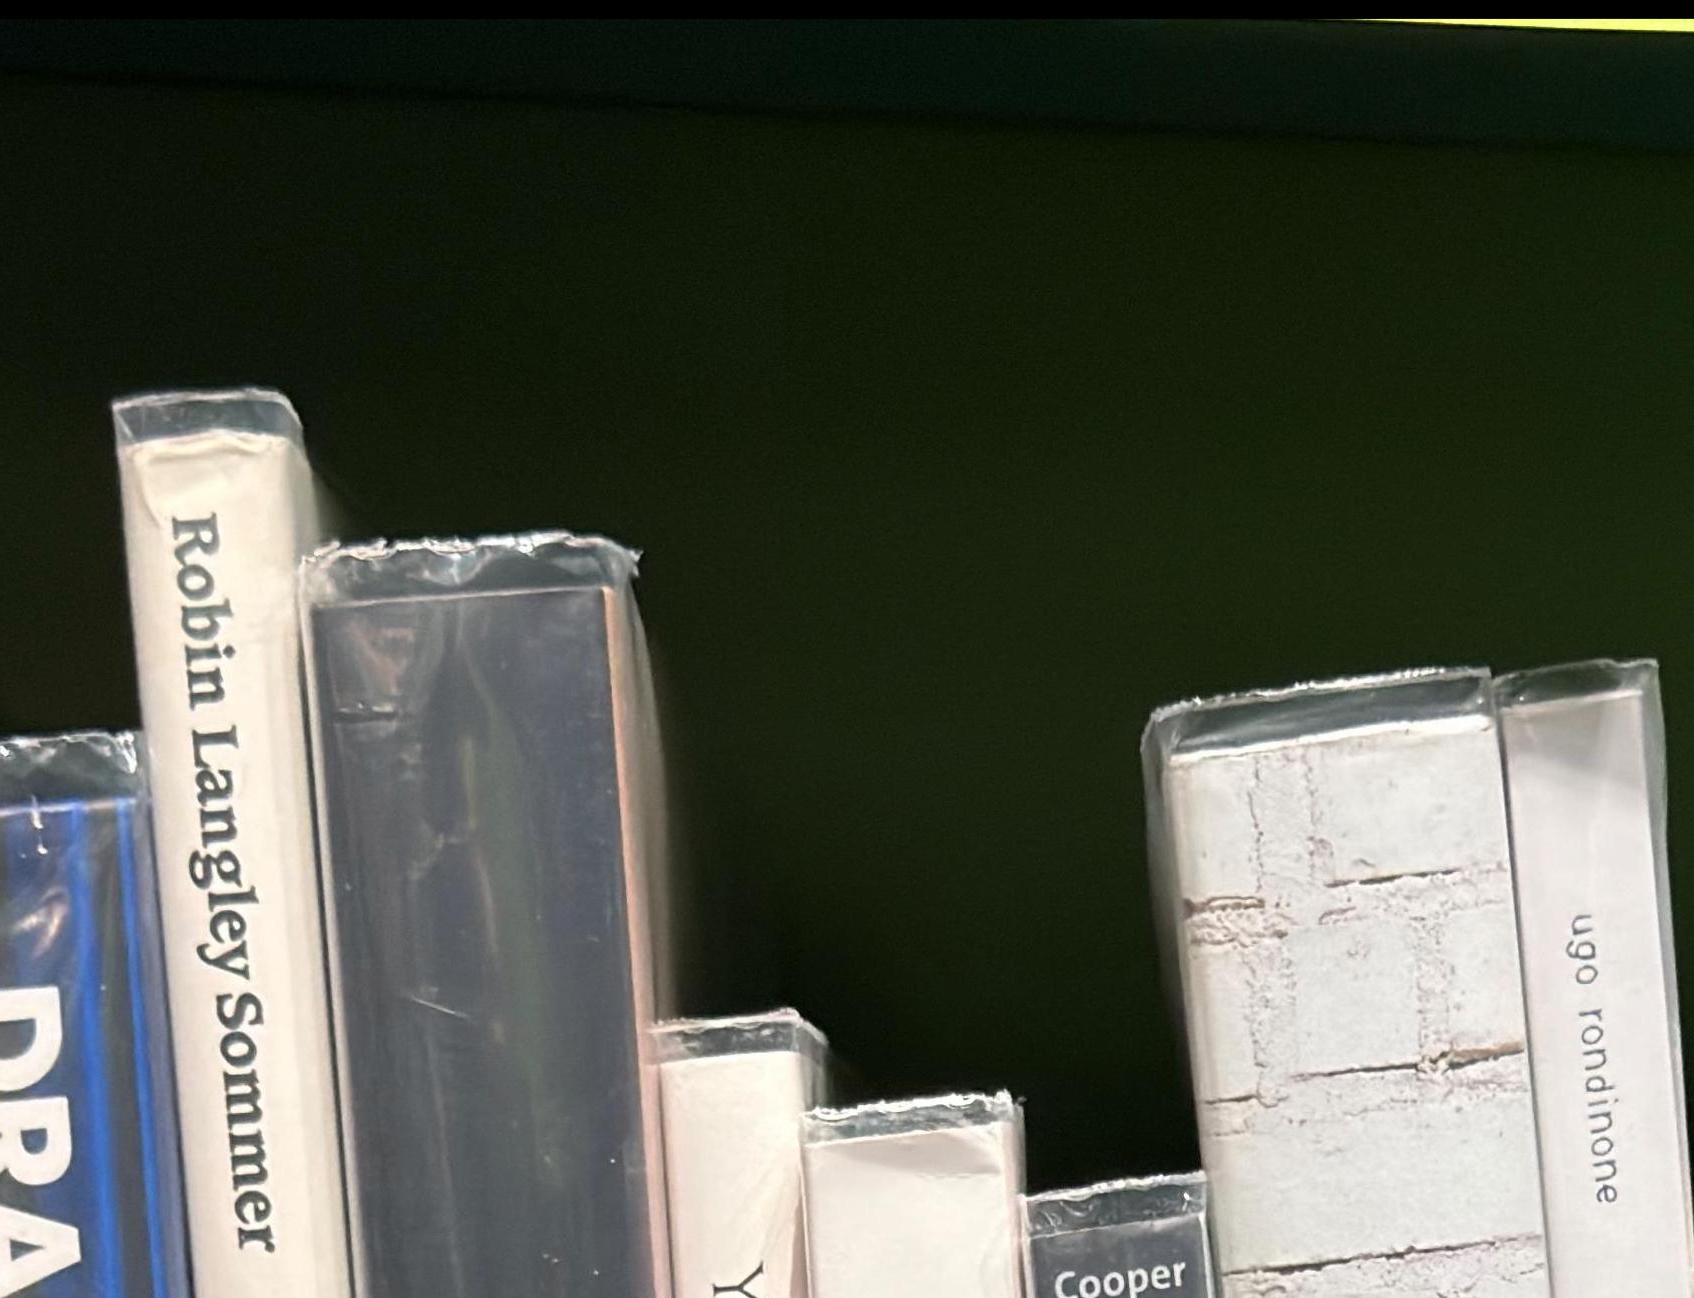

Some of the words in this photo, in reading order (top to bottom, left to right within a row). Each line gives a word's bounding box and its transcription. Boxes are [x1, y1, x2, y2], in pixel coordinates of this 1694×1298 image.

[172, 511, 236, 712] Robin
[188, 724, 259, 980] Langley
[1566, 914, 1598, 985] ugo
[215, 992, 276, 1254] Sommer
[1579, 1008, 1619, 1204] rondinone
